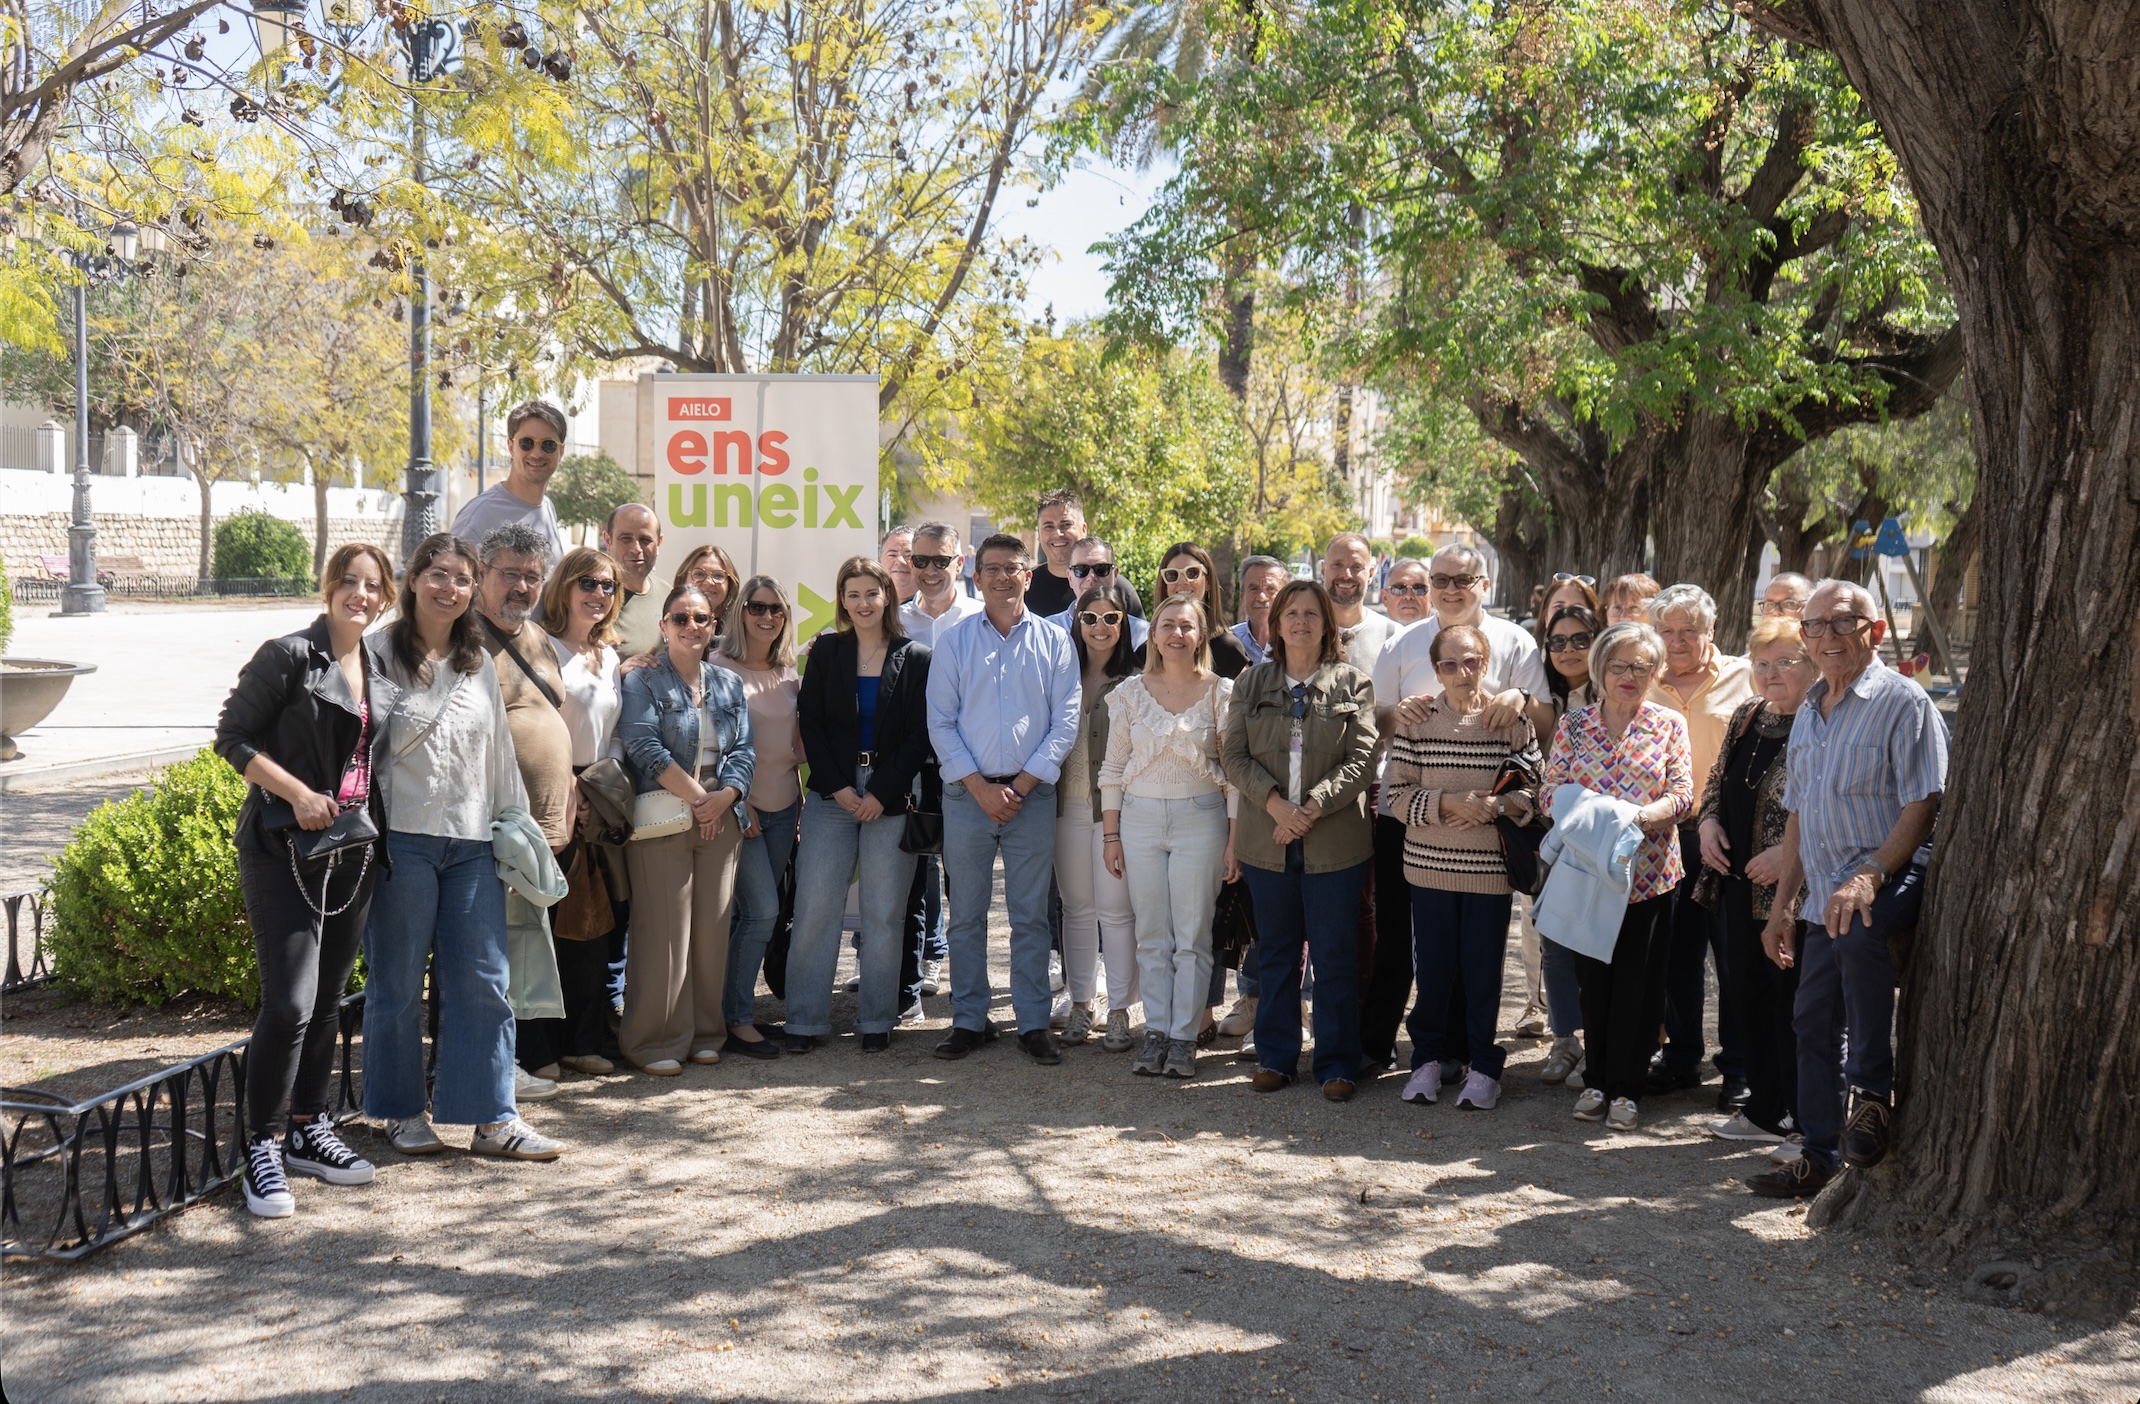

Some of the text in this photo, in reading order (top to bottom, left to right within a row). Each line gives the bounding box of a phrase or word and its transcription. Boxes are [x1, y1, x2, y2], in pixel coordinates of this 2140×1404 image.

[679, 403, 721, 417] AIELO
[667, 430, 790, 476] ens
[668, 467, 864, 529] uneix
